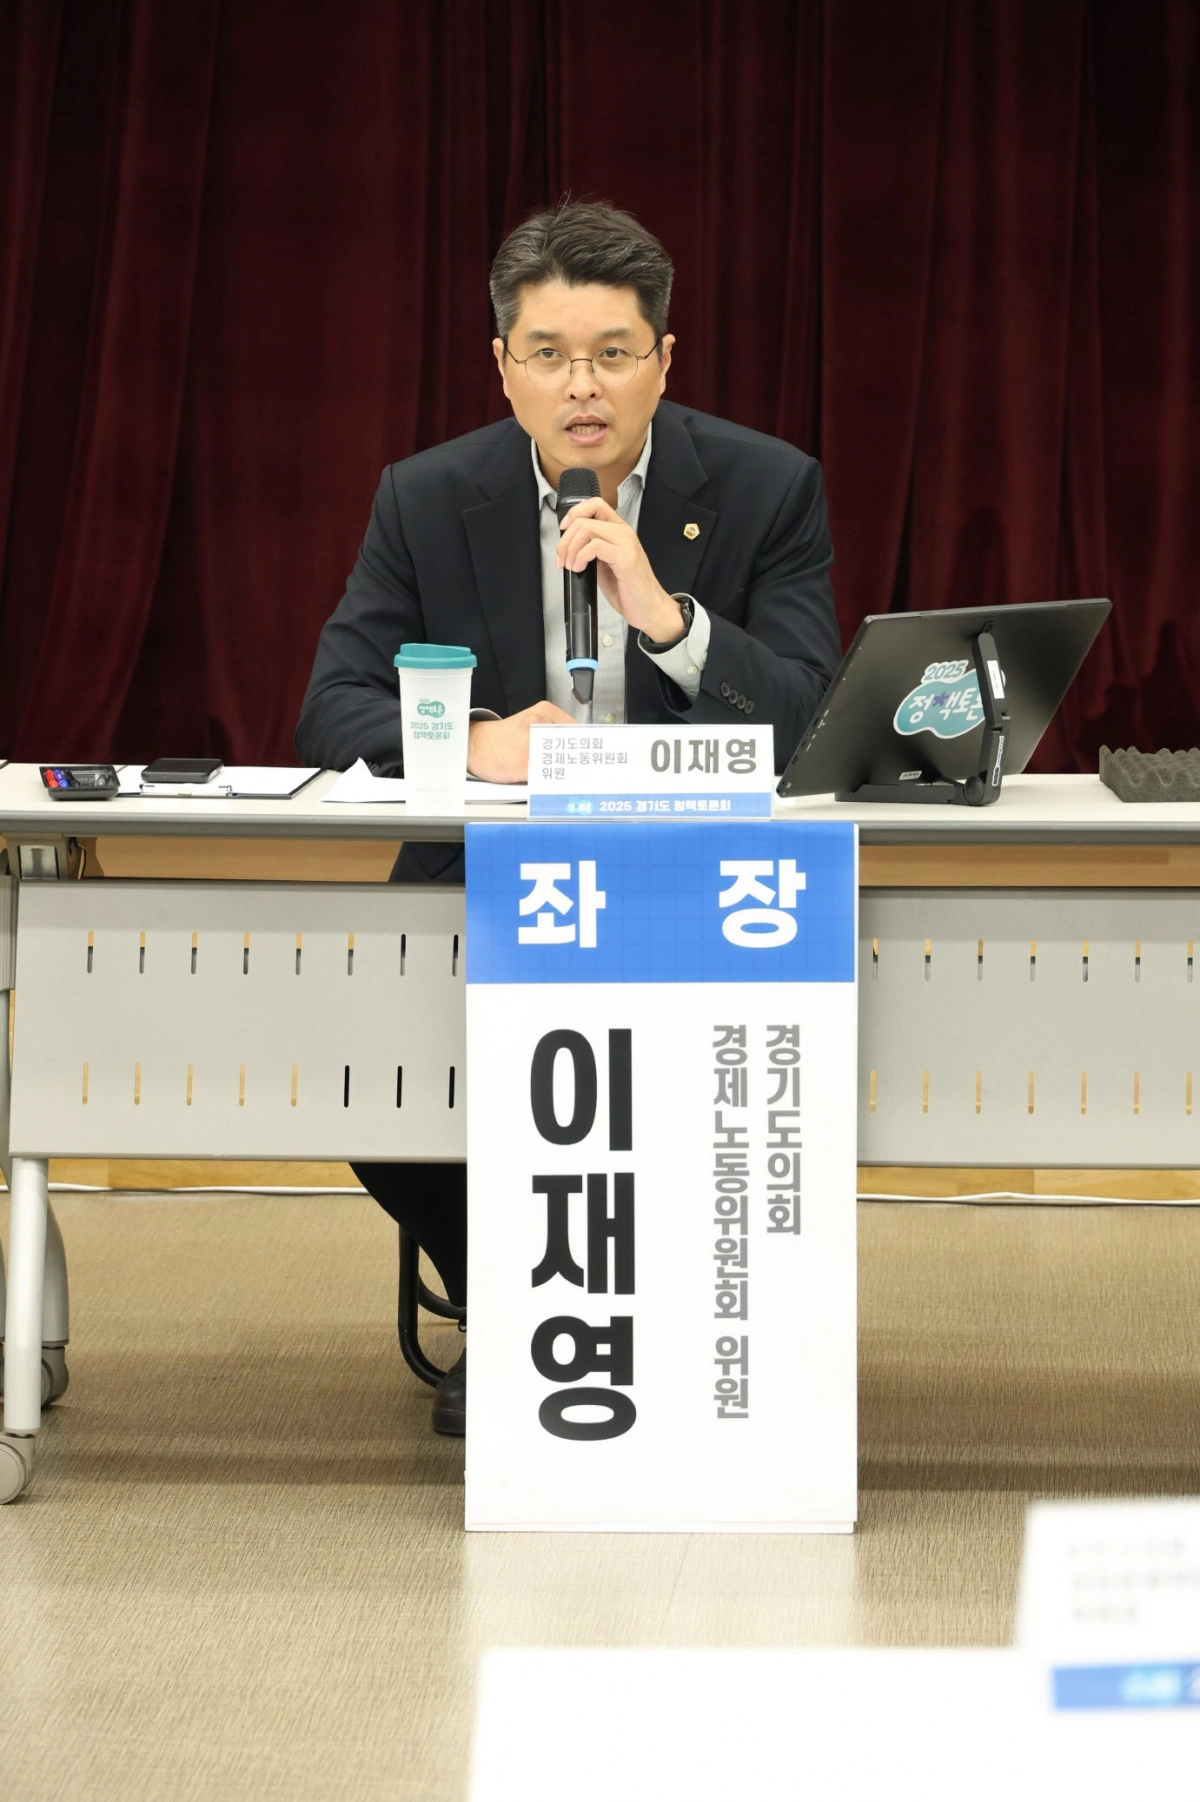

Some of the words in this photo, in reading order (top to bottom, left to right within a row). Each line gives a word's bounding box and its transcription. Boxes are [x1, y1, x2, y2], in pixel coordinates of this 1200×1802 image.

[923, 663, 966, 681] 2025
[410, 721, 429, 730] 2025
[431, 722, 454, 731] 경기도
[413, 731, 450, 740] 정책토론회
[541, 737, 603, 751] 경기도의회
[541, 751, 628, 766] 경제노동위원회
[650, 738, 757, 775] 이재영
[541, 767, 566, 780] 위원
[599, 800, 632, 812] 2025
[635, 800, 671, 813] 경기도
[673, 799, 732, 813] 정책토론회
[764, 1024, 803, 1236] 경기도의회
[711, 1024, 750, 1322] 경제노동위원회
[529, 1027, 637, 1442] 이재영
[712, 1334, 750, 1420] 위원
